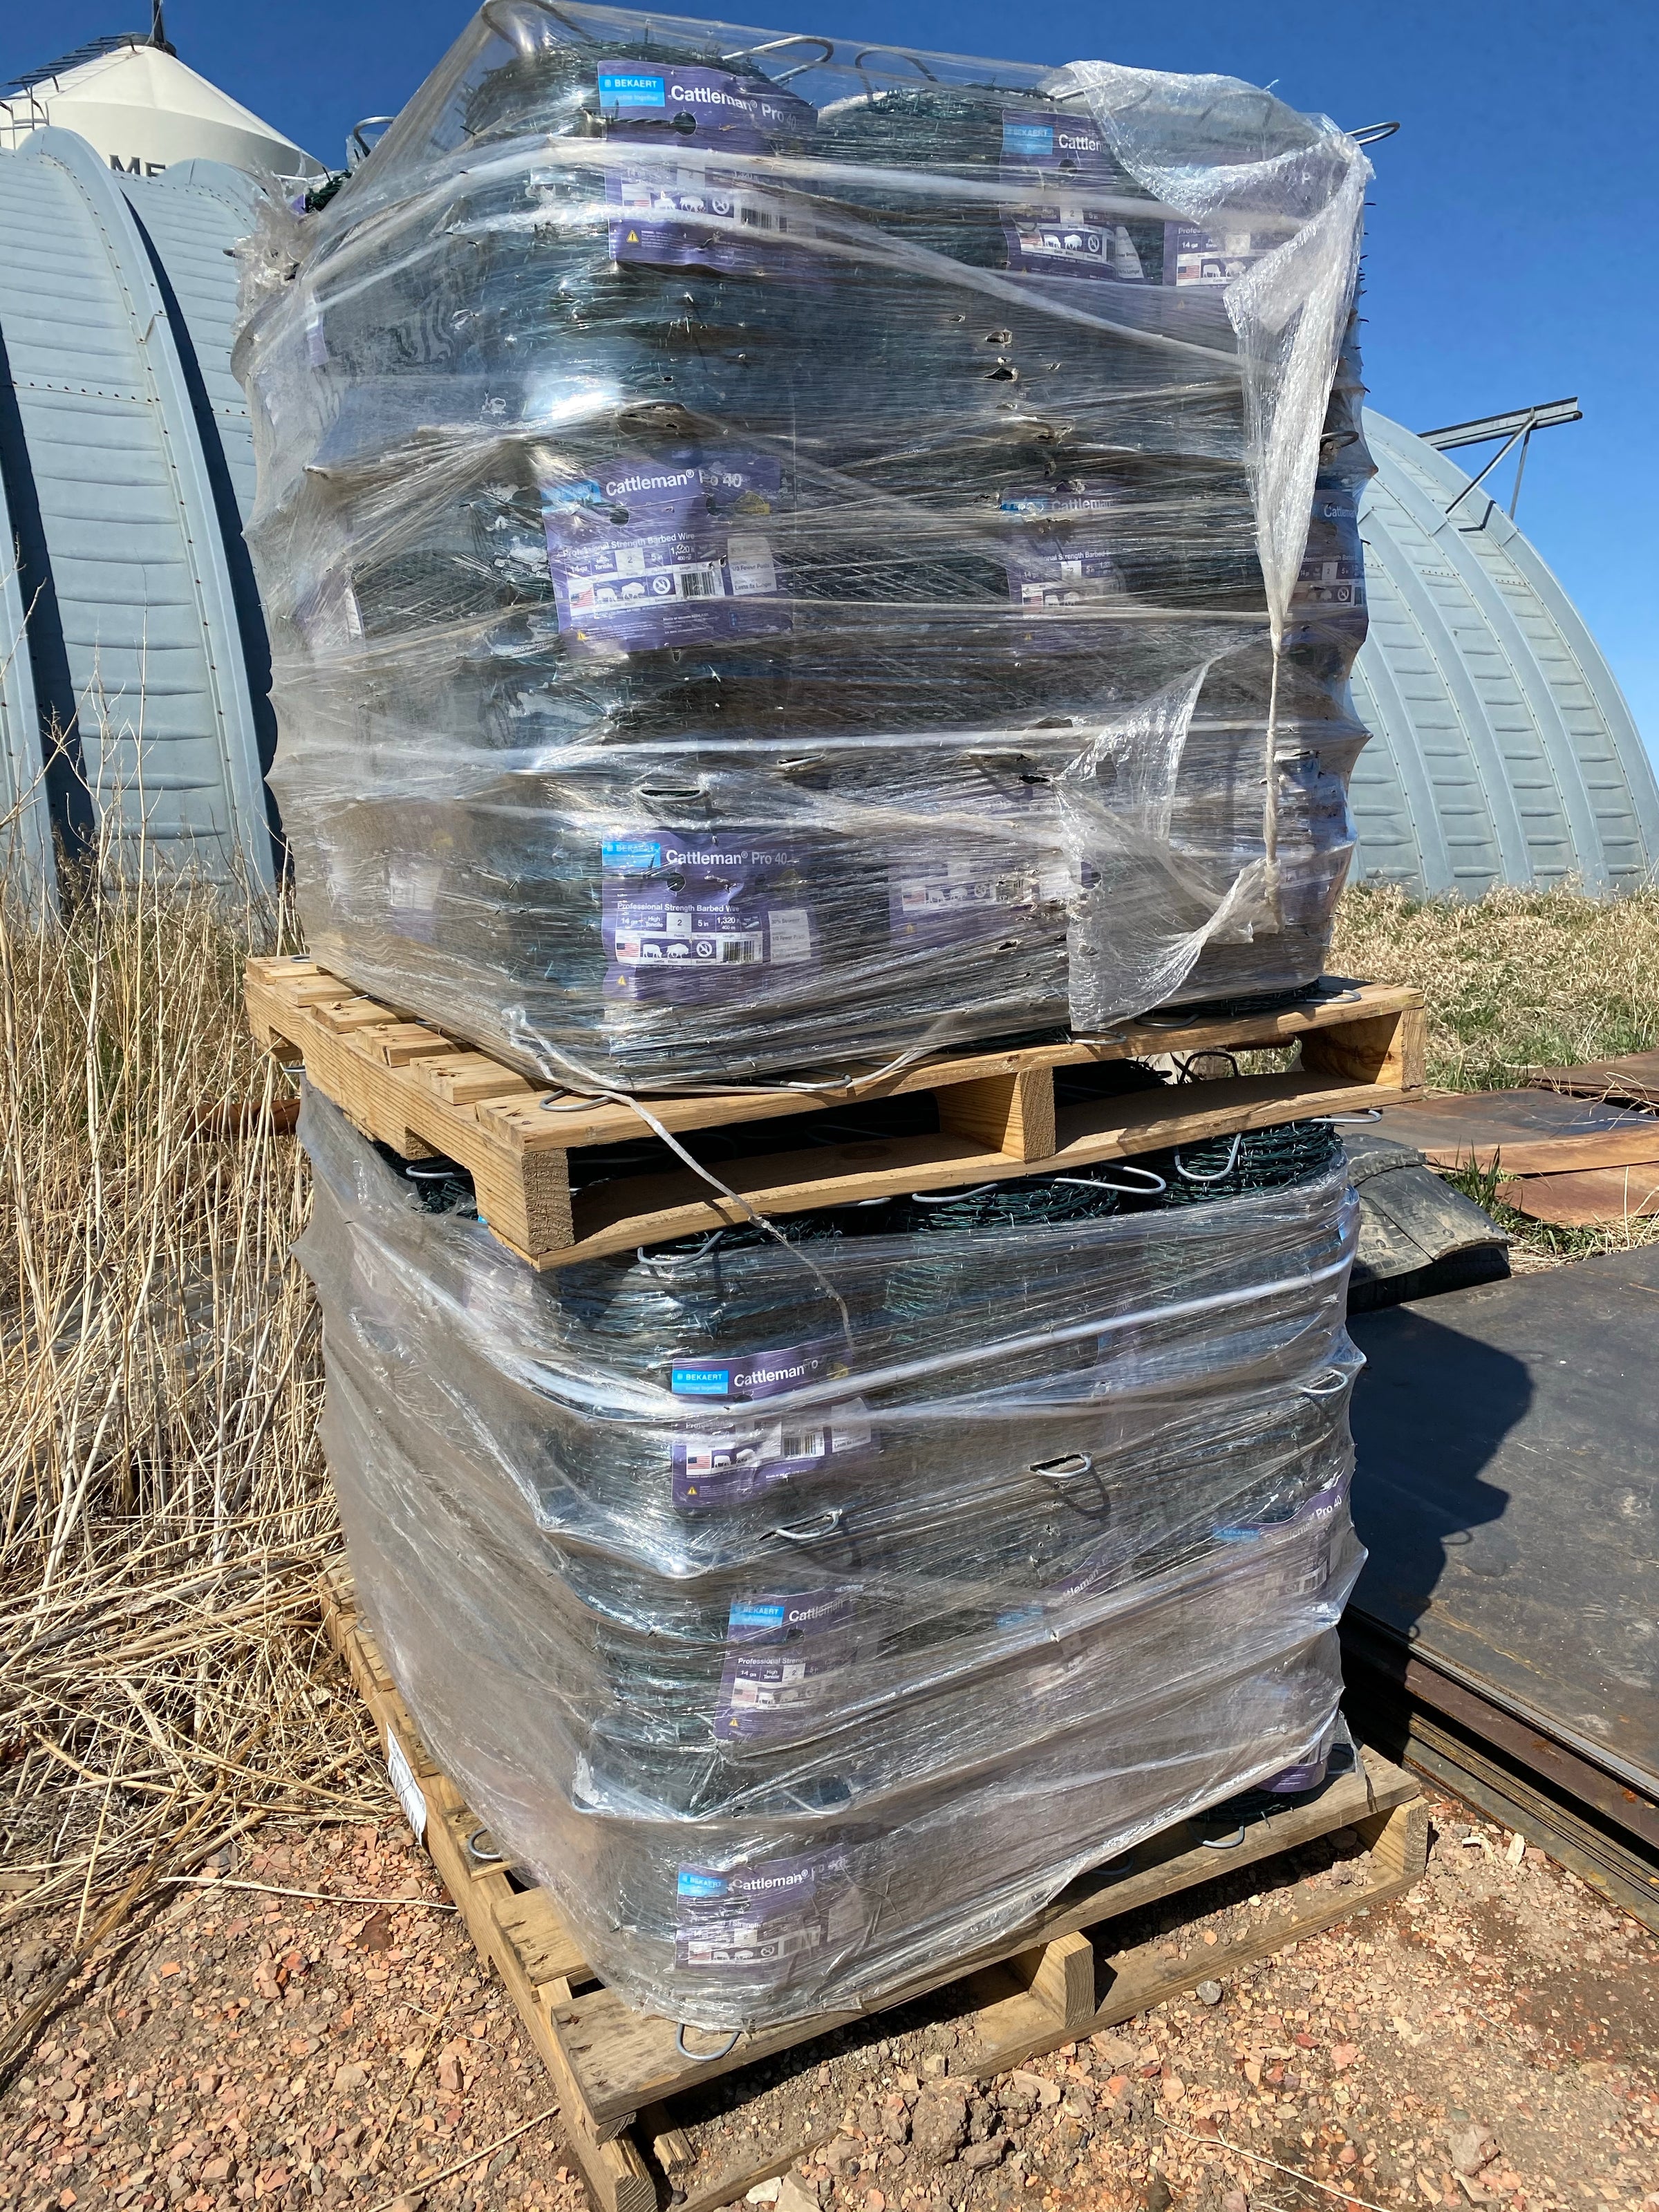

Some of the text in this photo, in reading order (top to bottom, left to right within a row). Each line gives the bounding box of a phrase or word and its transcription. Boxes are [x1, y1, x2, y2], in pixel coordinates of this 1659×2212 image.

[615, 79, 657, 88] BEKAERT
[762, 104, 785, 123] Pro
[722, 473, 742, 488] 40
[611, 537, 646, 549] Strength
[648, 532, 676, 543] Barbed
[678, 532, 695, 541] Wire
[1058, 552, 1084, 562] Srength
[666, 850, 787, 865] Cattleman® Pro 40
[665, 904, 695, 912] Strength
[697, 919, 703, 928] 5
[717, 917, 735, 925] 1,320
[686, 1373, 722, 1381] BEKAERT
[734, 1366, 804, 1387] Cattleman
[1315, 1505, 1333, 1519] Pro
[1334, 1495, 1342, 1508] 40
[743, 1606, 779, 1615] BEKAERT
